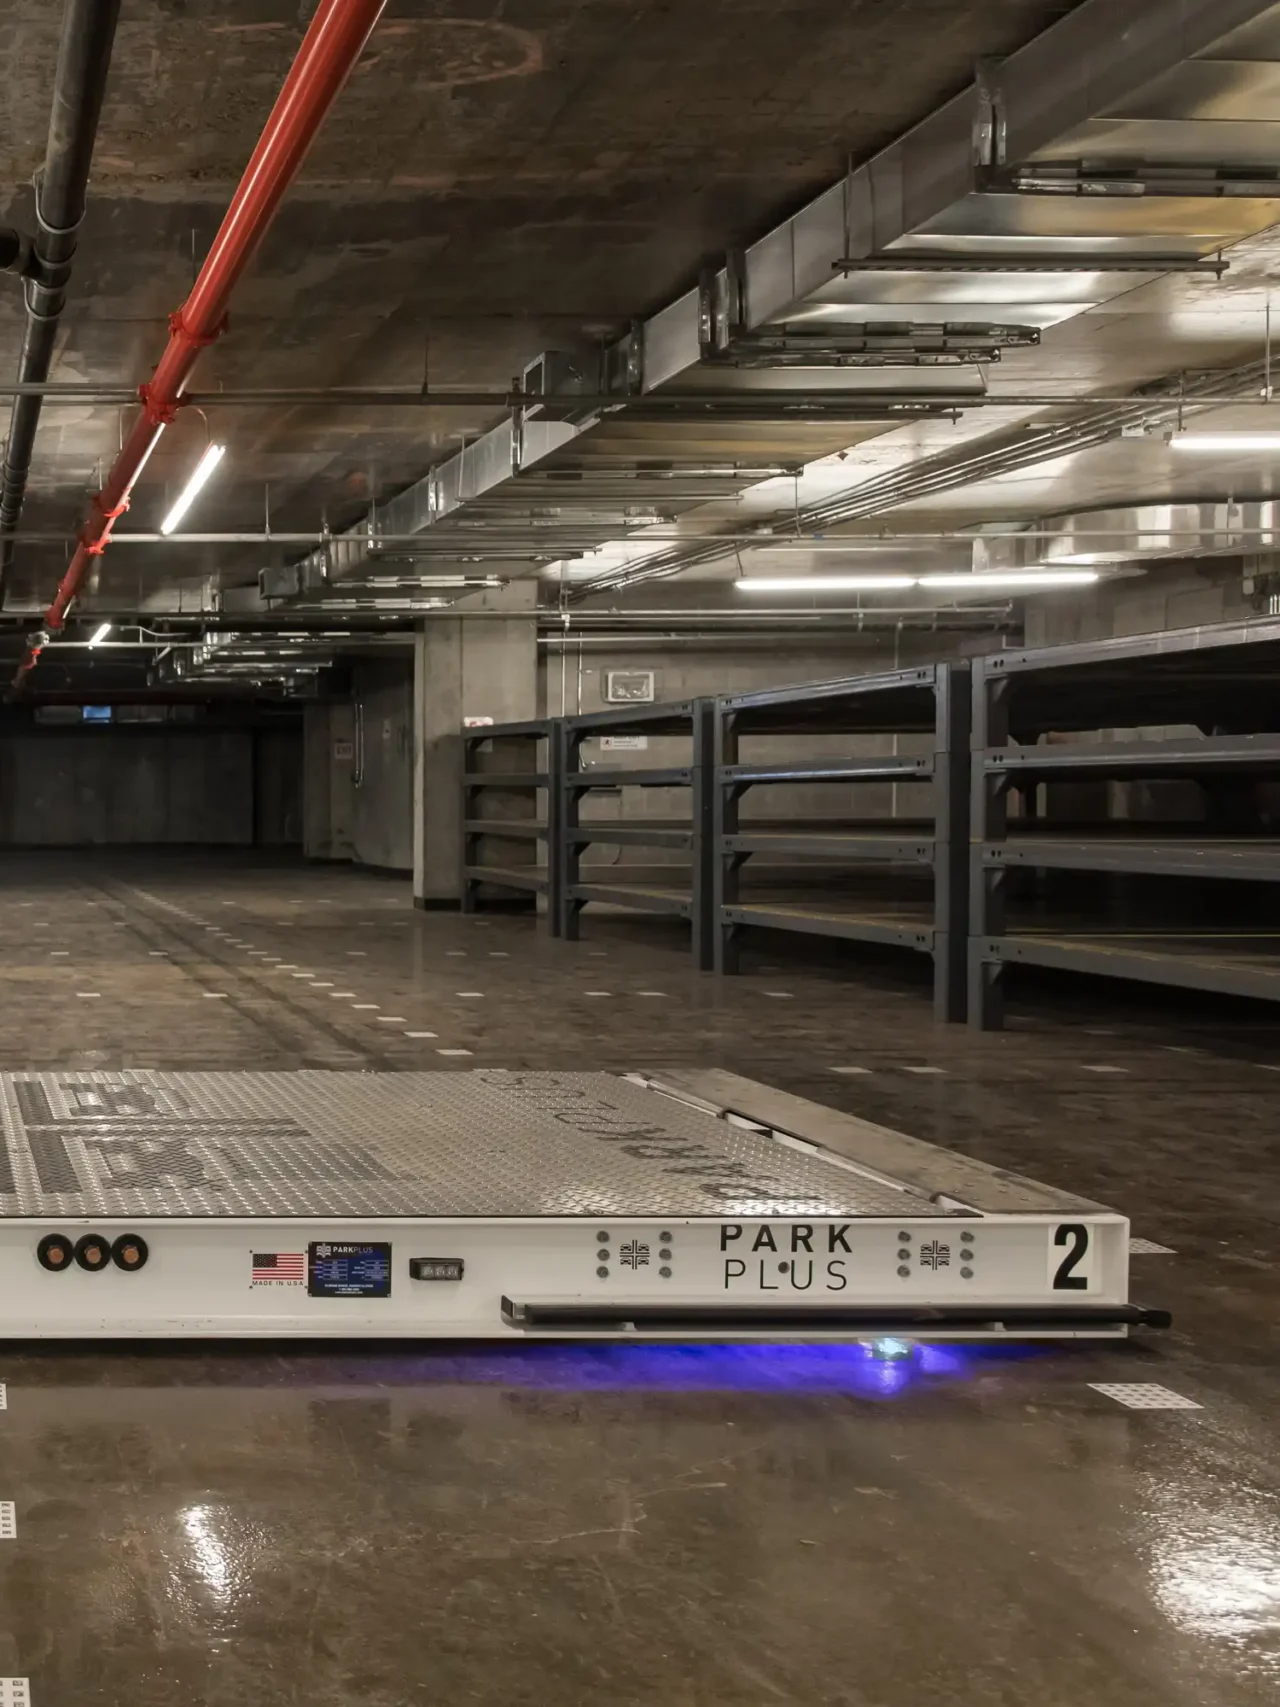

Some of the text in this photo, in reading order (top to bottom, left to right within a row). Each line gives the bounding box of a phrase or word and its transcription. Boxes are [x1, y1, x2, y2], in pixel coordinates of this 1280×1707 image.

[720, 1224, 853, 1253] PARK
[1052, 1223, 1090, 1291] 2
[724, 1259, 847, 1291] PLUS
